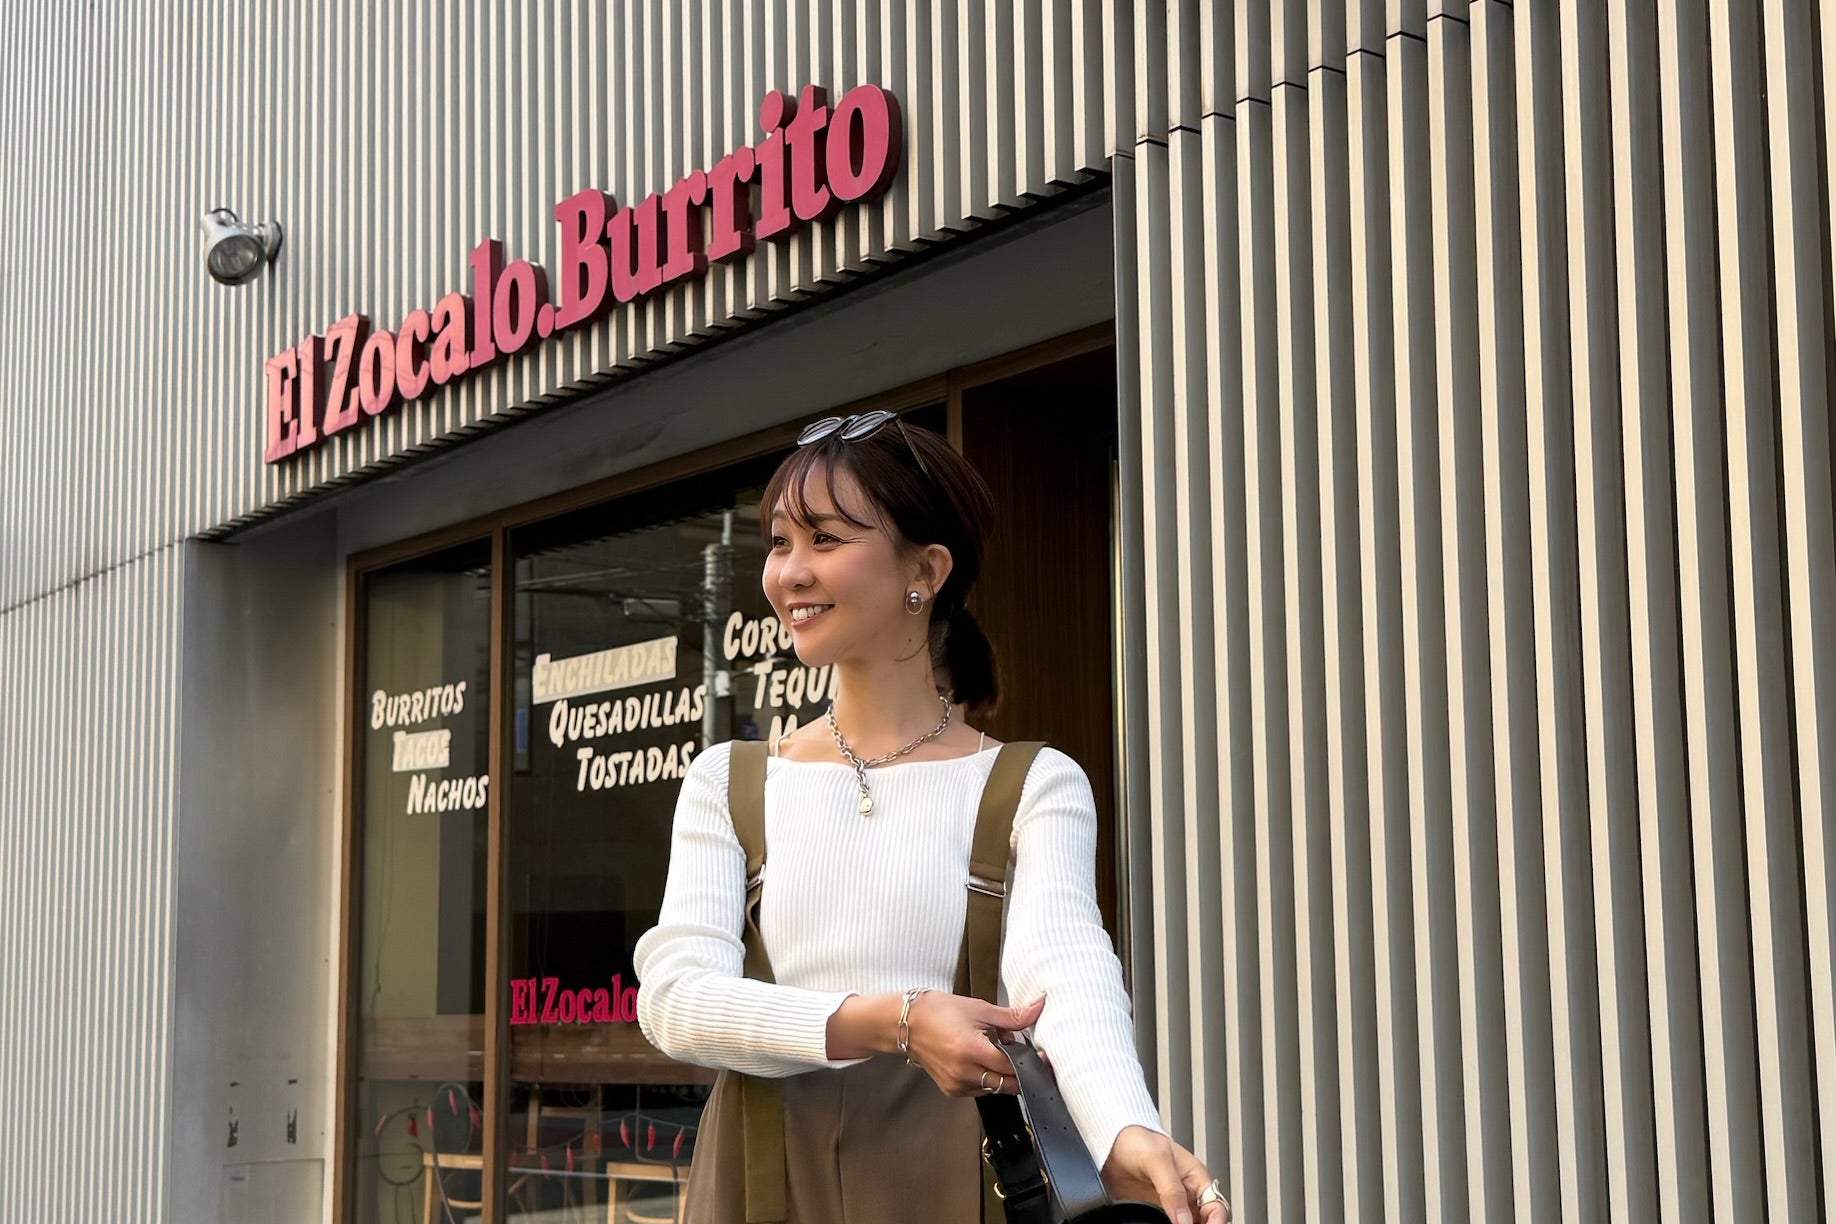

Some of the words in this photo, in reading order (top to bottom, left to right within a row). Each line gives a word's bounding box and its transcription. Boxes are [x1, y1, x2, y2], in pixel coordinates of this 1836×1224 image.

[533, 635, 678, 699] ENCHILADAS
[371, 681, 467, 730] BURRITOS
[549, 684, 707, 748] QUESADILLAS
[393, 729, 451, 771] TACOS
[577, 741, 695, 792] TOSTADAS
[406, 773, 490, 815] NACHOS
